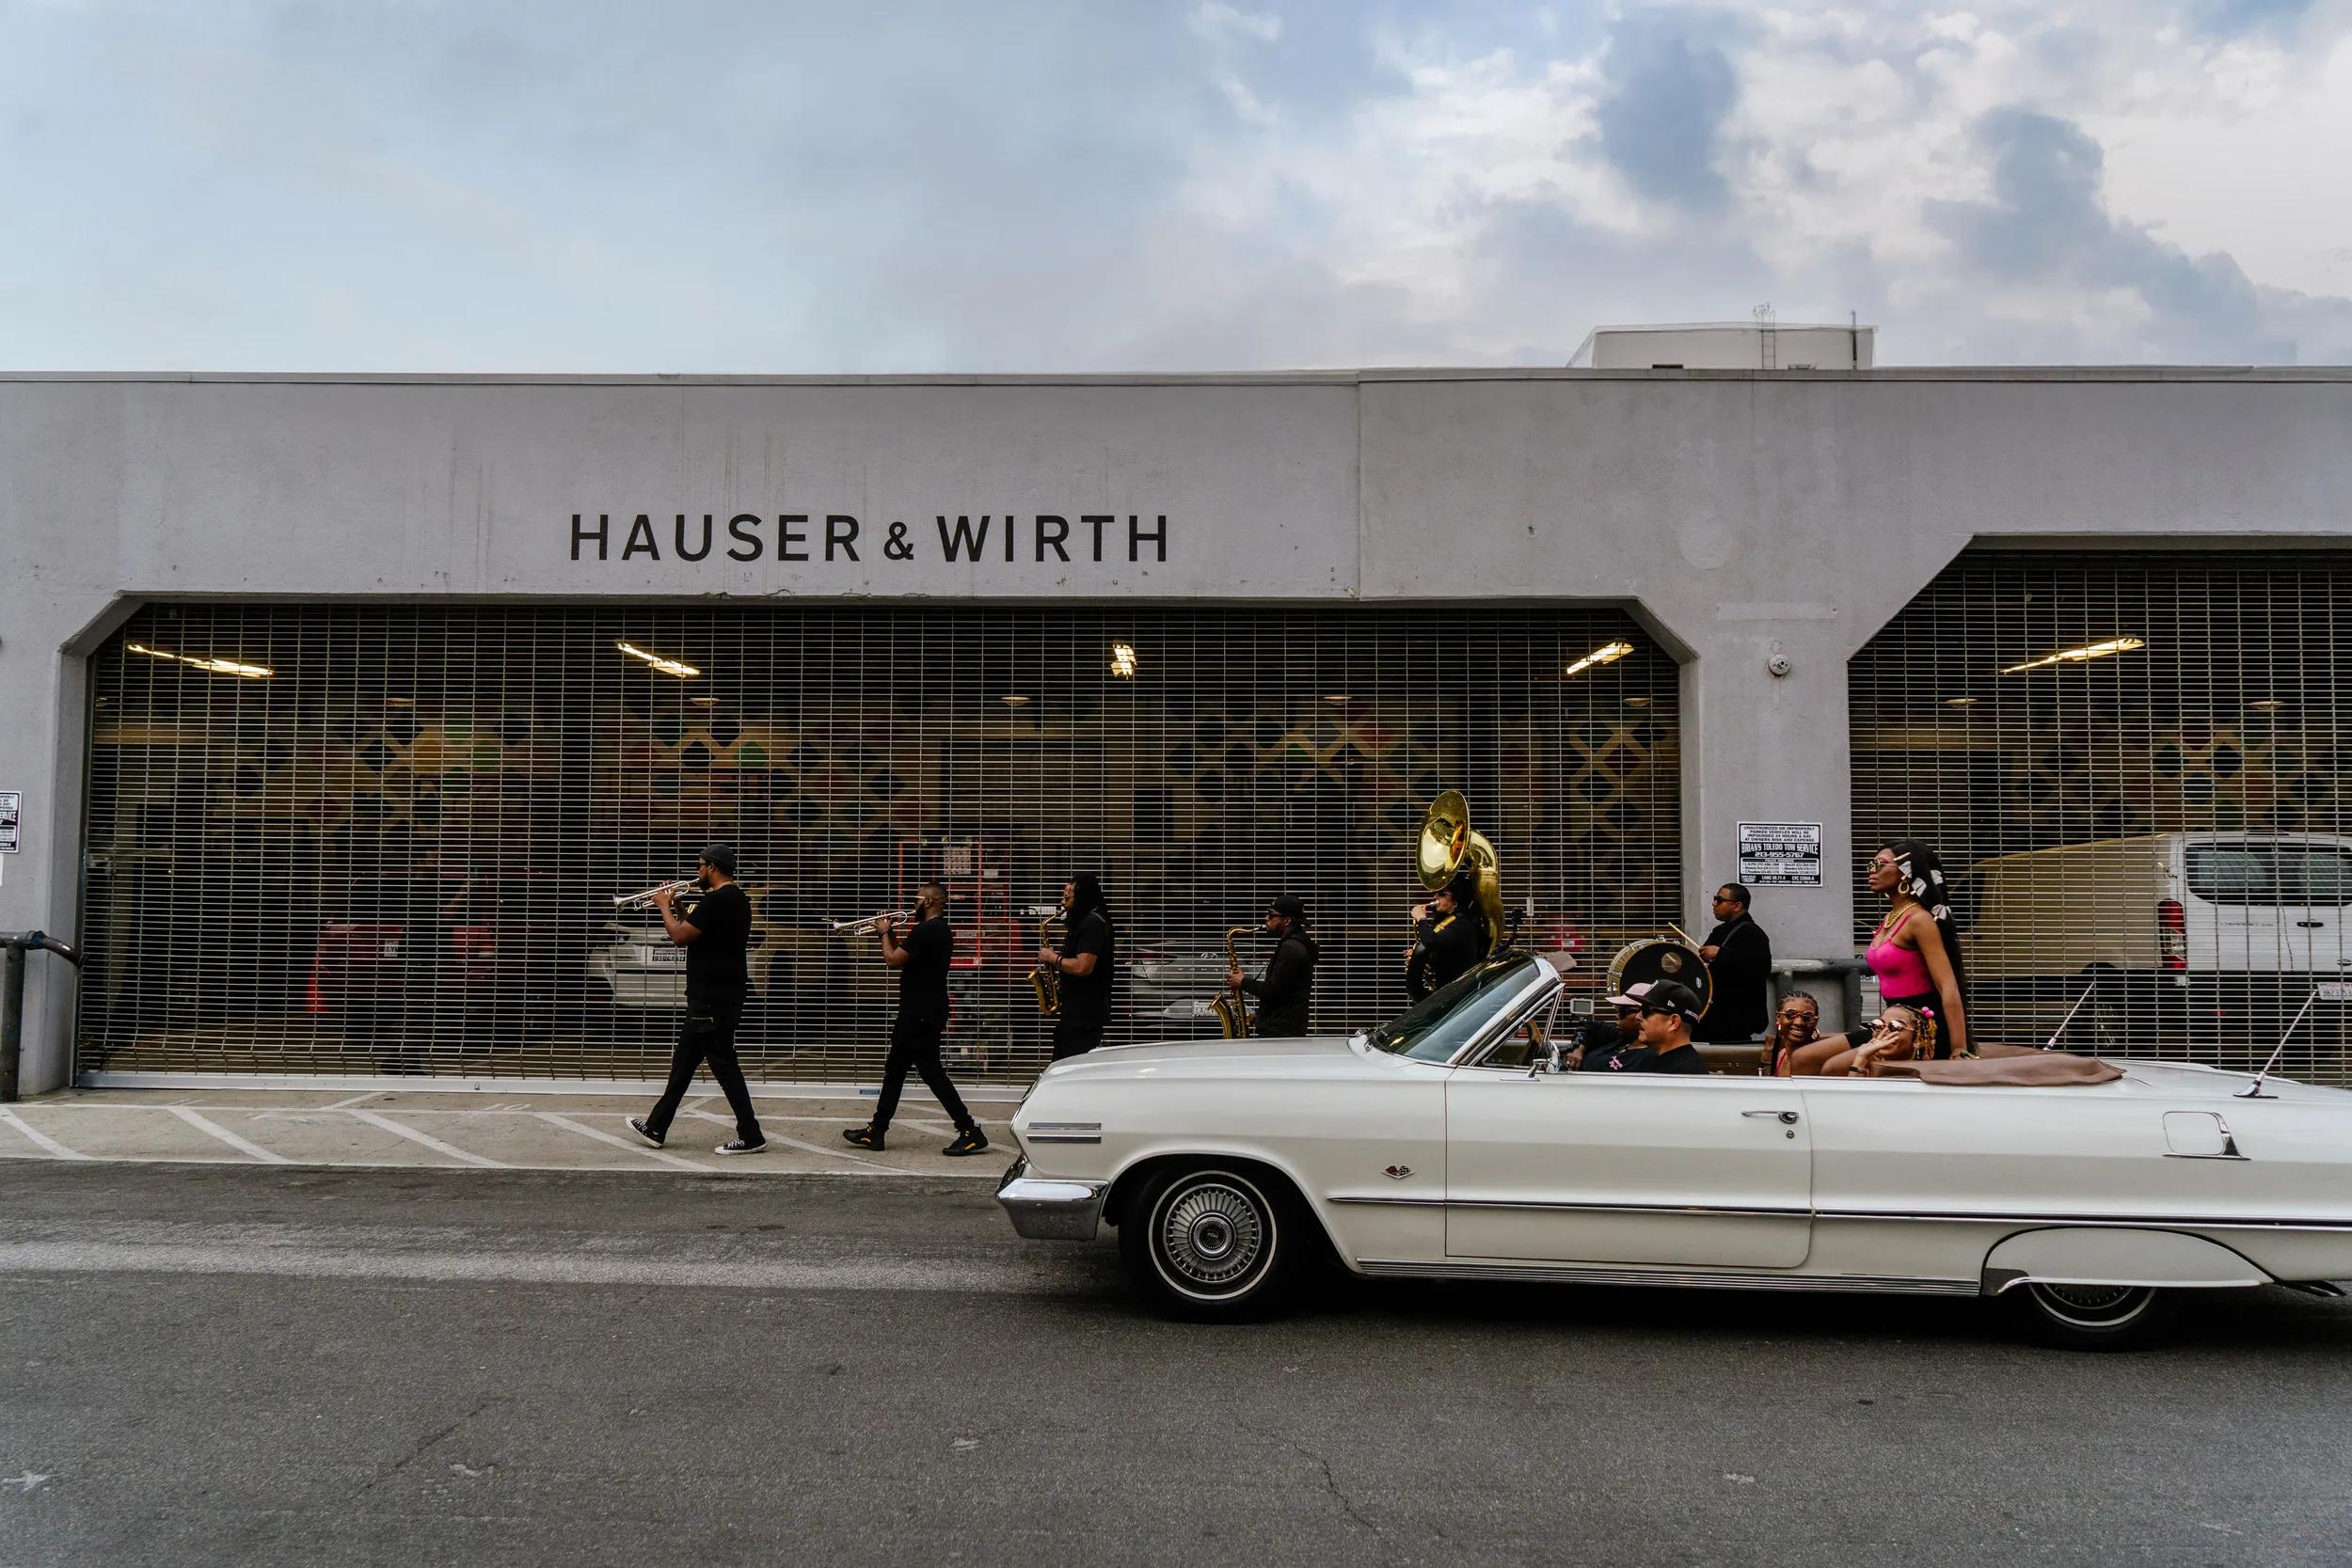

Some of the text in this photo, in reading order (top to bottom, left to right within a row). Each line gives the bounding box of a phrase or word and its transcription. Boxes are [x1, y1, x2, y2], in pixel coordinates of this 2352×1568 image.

[570, 514, 1167, 562] HAUSER & WIRTH
[1797, 844, 1818, 855] SERVICE
